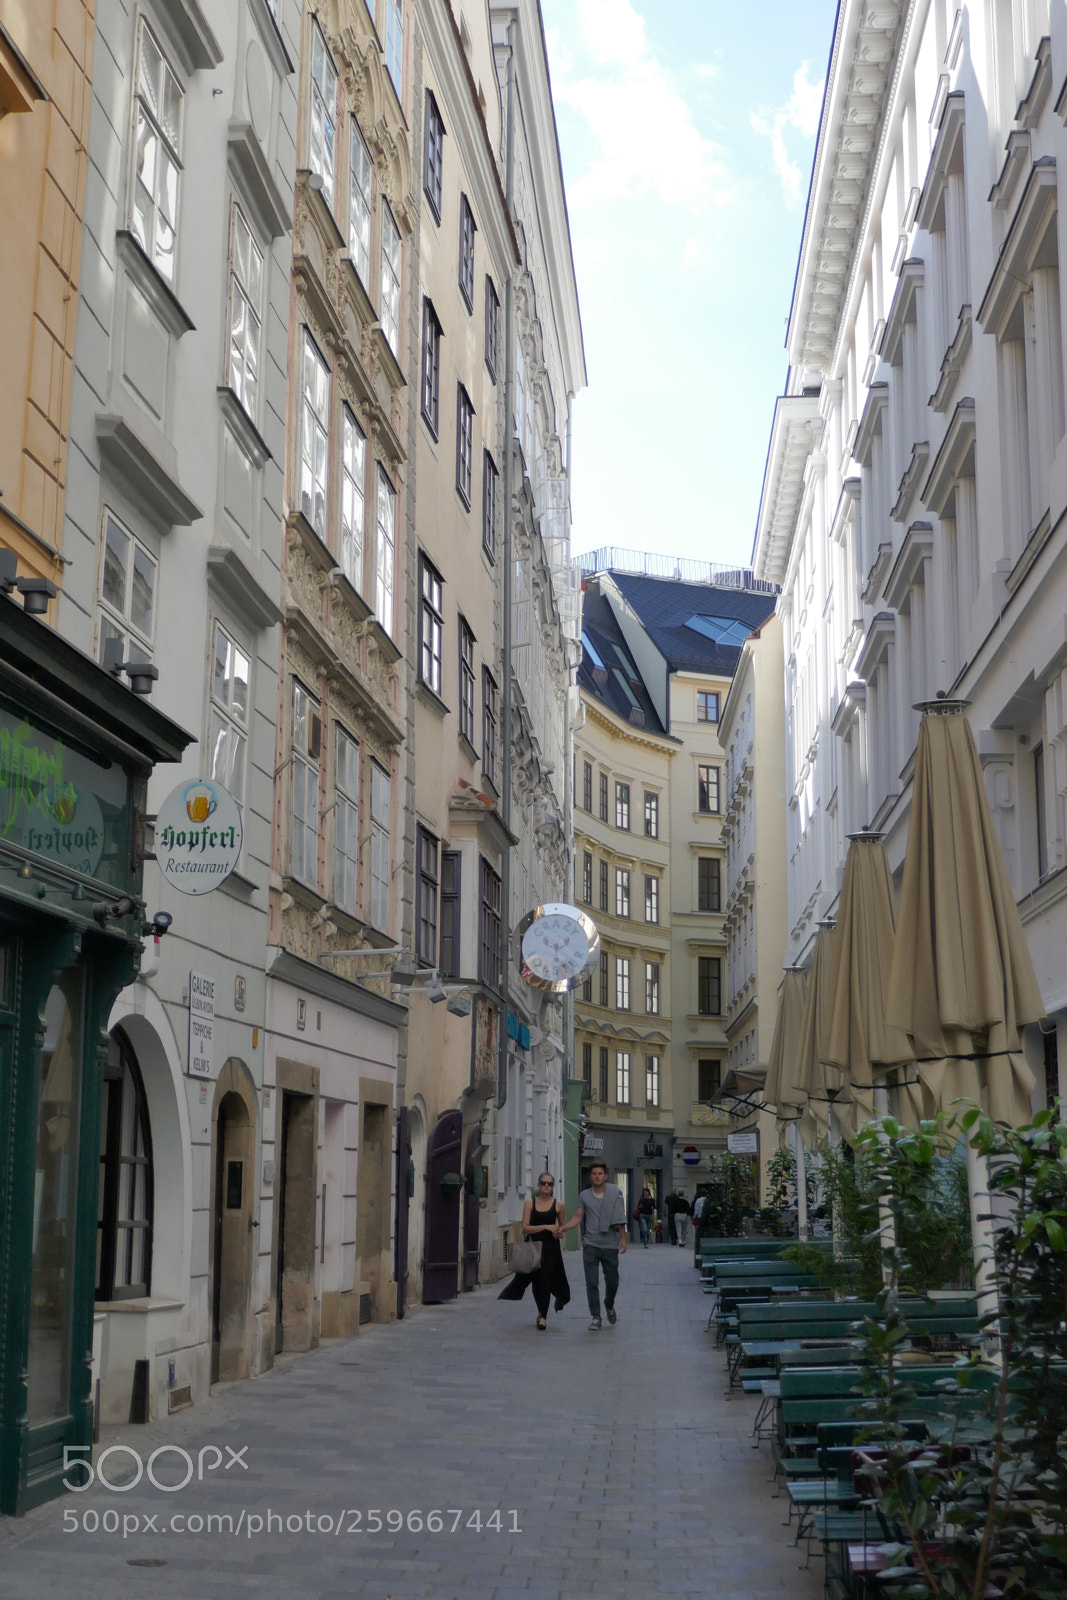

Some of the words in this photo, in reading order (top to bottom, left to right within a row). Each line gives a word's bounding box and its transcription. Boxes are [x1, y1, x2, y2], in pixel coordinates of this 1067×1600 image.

[160, 825, 236, 854] Hopferl
[165, 858, 230, 875] Restaurant
[534, 921, 579, 937] CRAZY
[192, 975, 215, 999] GALERIE
[192, 1021, 212, 1039] TEPPICHE
